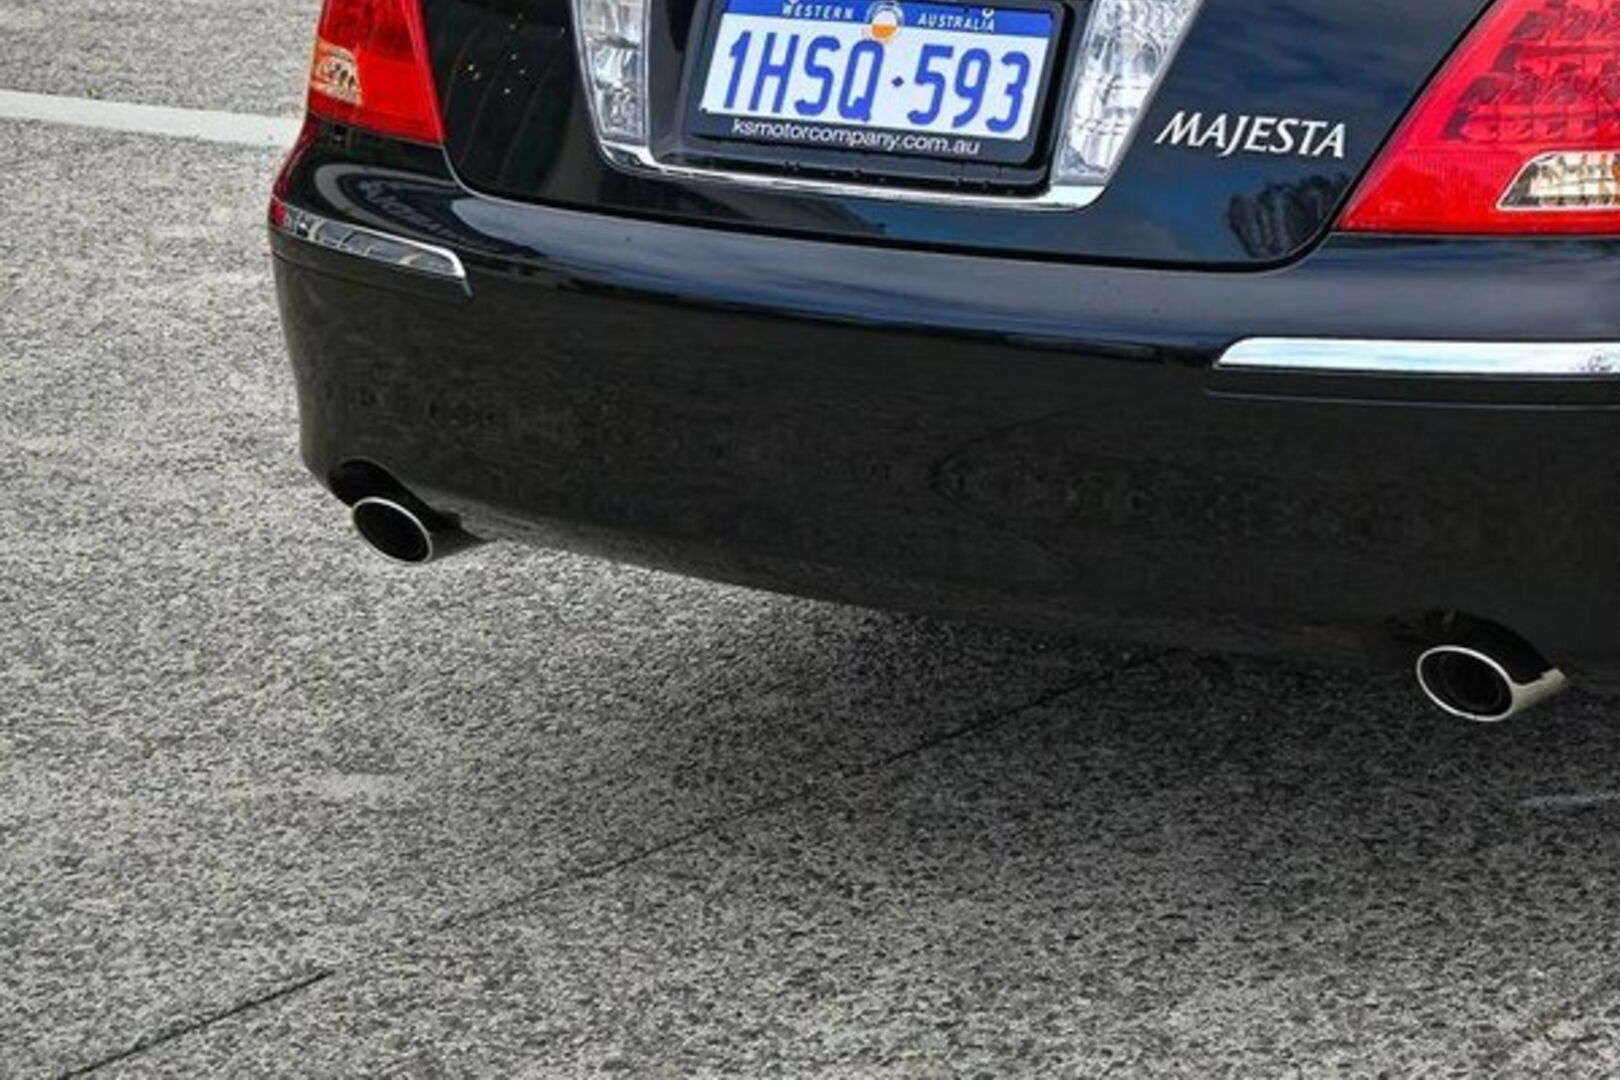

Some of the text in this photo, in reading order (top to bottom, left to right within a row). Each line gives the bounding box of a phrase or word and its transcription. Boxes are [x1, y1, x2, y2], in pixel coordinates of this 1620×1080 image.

[782, 2, 995, 33] WESTERN AUSTRALIA
[731, 119, 981, 156] ksmotorcompany.com.au
[1154, 110, 1347, 159] MAJESTA
